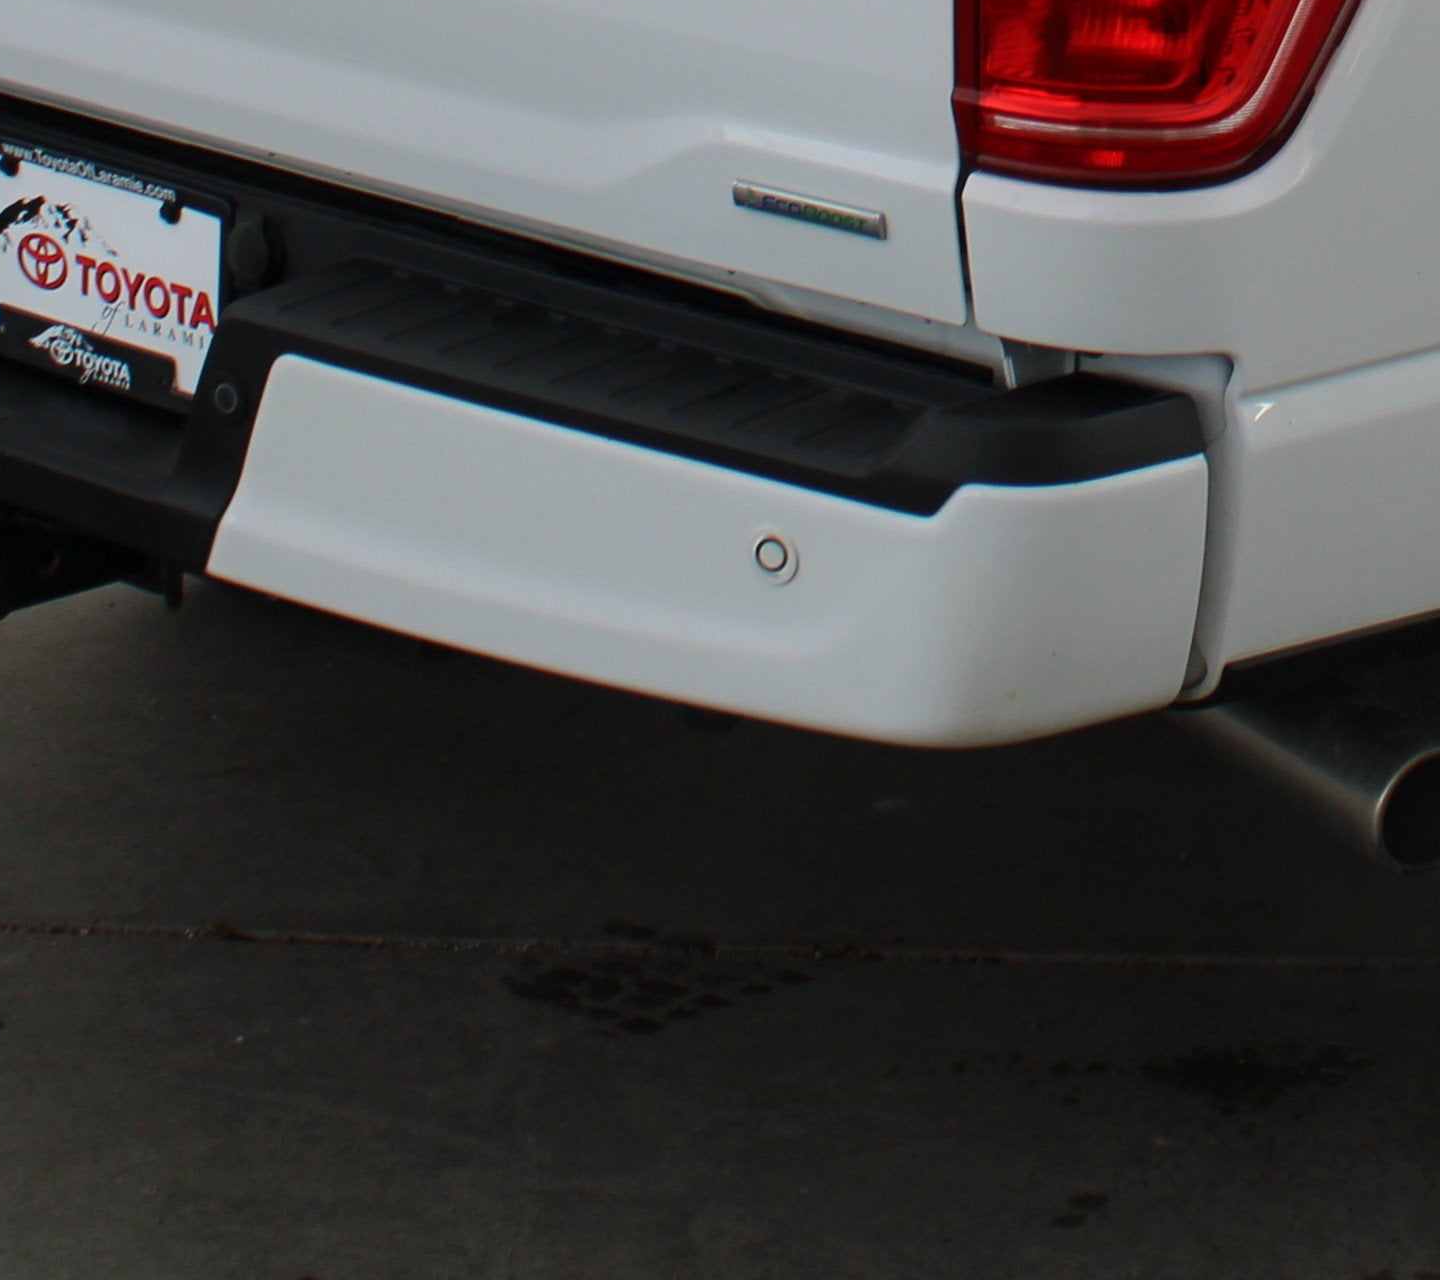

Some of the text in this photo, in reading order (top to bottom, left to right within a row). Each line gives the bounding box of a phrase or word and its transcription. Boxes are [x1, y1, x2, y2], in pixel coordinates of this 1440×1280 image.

[75, 253, 217, 333] TOYOTA
[124, 313, 205, 350] LARAMI
[74, 347, 132, 383] TOYOTA
